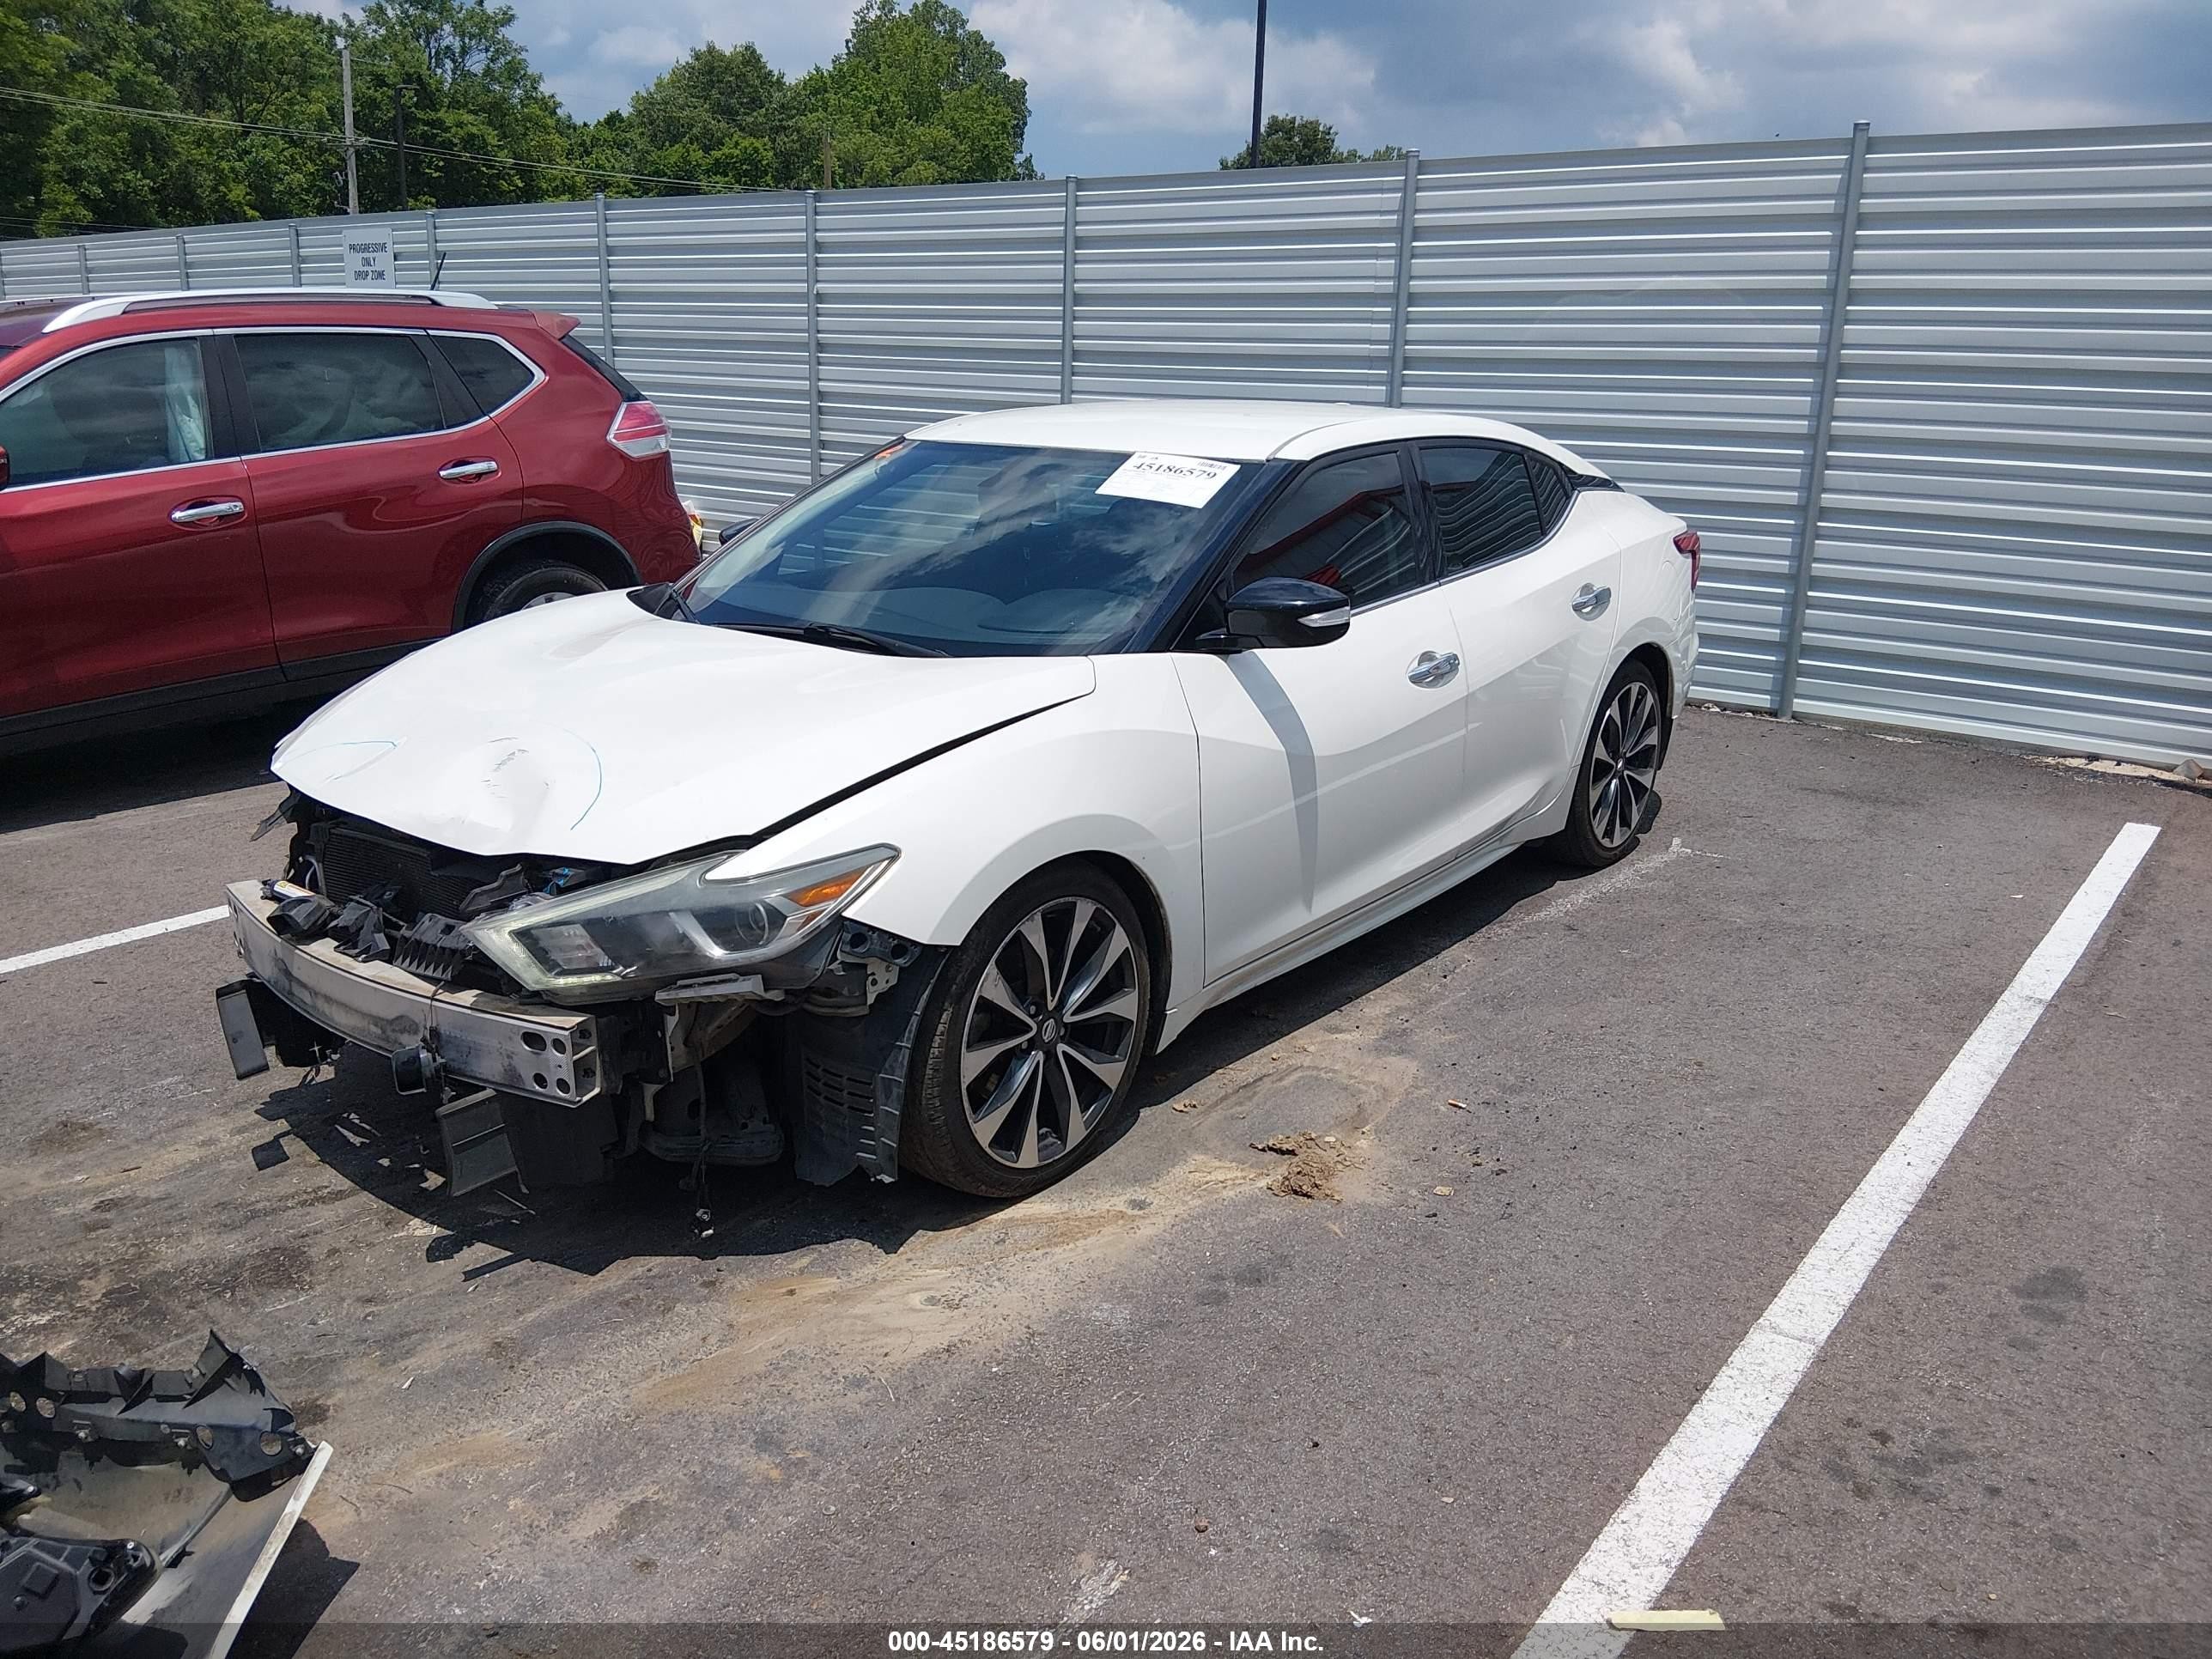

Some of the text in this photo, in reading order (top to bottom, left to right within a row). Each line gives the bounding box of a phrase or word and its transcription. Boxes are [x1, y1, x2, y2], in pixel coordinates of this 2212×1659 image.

[349, 242, 387, 254] PROGRESSIVE
[361, 256, 376, 267] ONLY
[354, 270, 386, 281] DROP ZONE
[1133, 461, 1217, 480] 45186579
